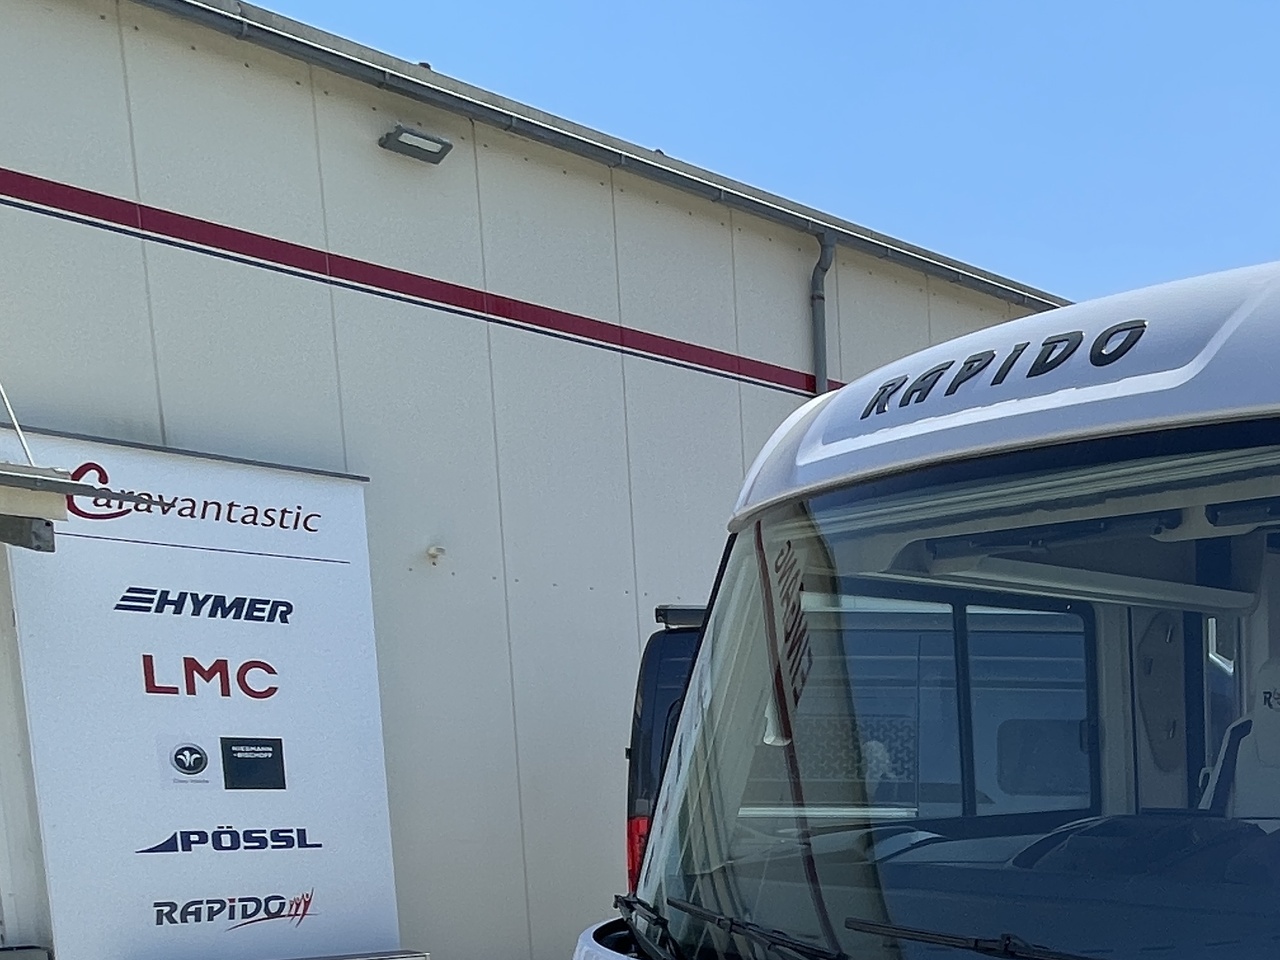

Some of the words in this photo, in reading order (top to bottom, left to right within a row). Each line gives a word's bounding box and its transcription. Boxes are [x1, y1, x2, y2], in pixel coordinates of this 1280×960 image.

[860, 318, 1150, 421] RAPIDO
[147, 588, 294, 625] HYMER
[142, 654, 279, 700] LMC
[180, 826, 323, 852] PÖSSL
